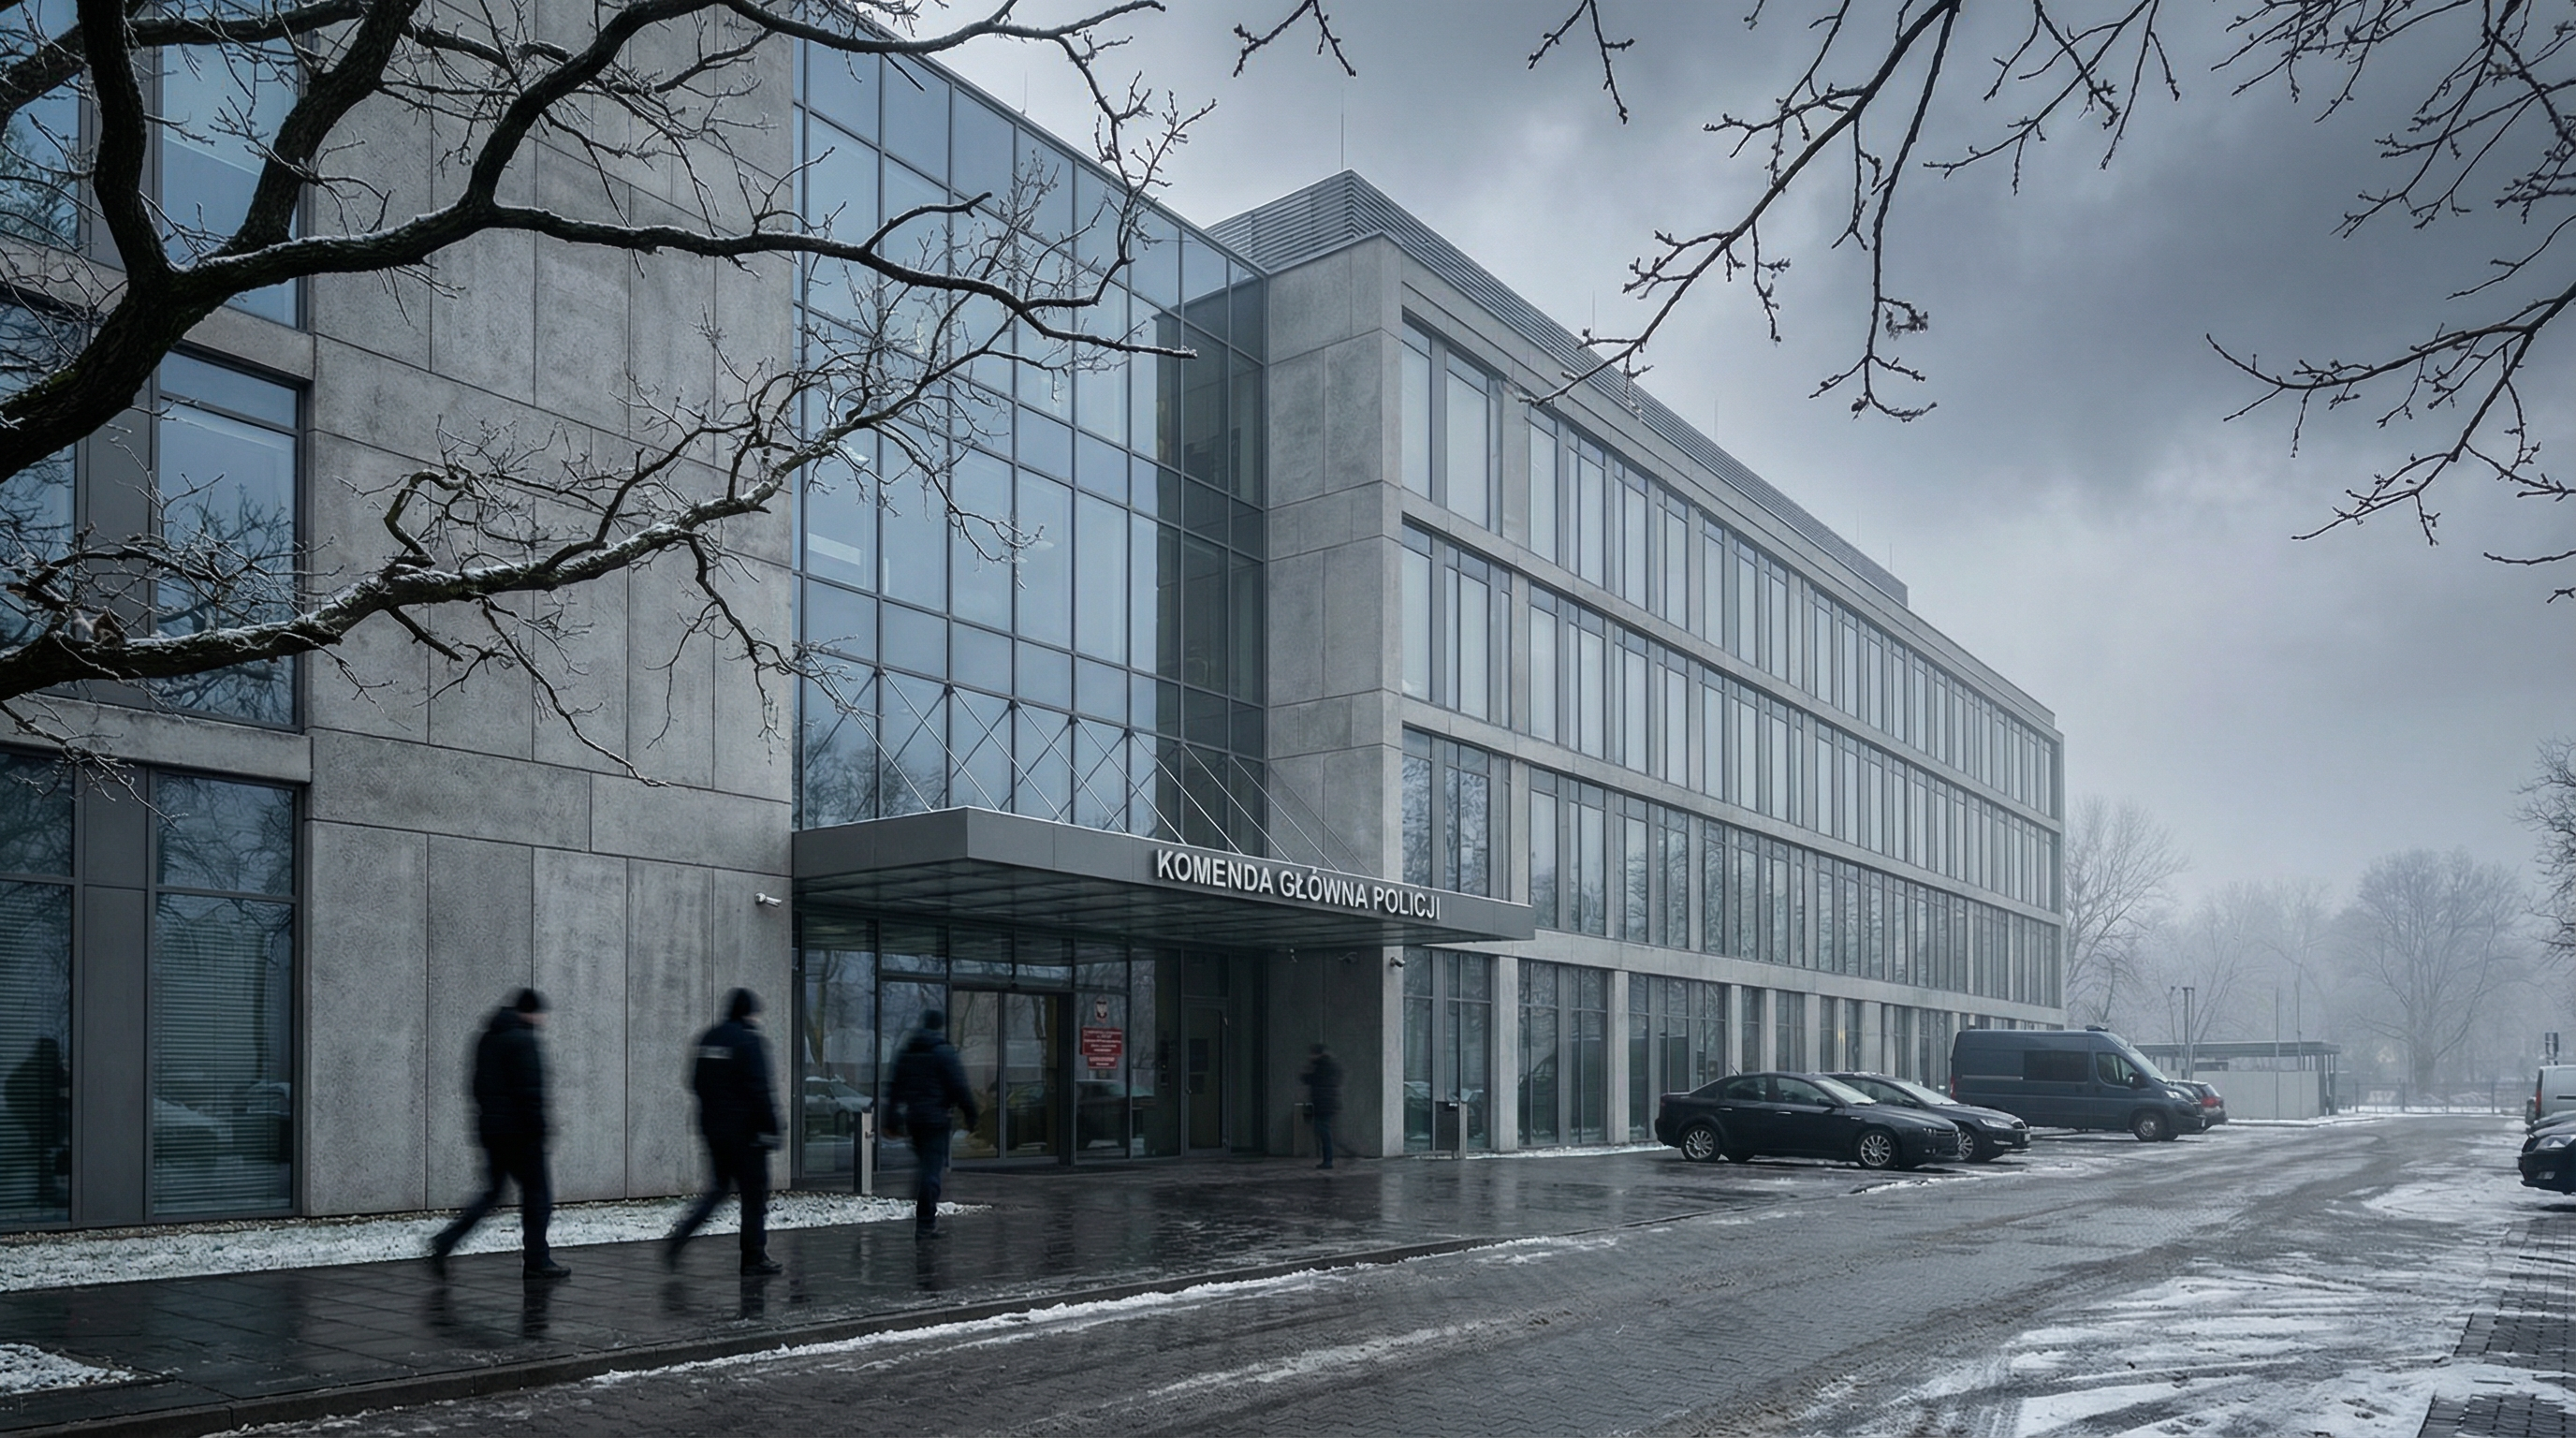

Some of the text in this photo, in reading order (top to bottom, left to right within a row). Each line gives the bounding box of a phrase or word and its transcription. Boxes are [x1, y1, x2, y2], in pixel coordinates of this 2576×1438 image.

[1157, 849, 1441, 920] KOMENDA GŁÓWNA POLICJI
